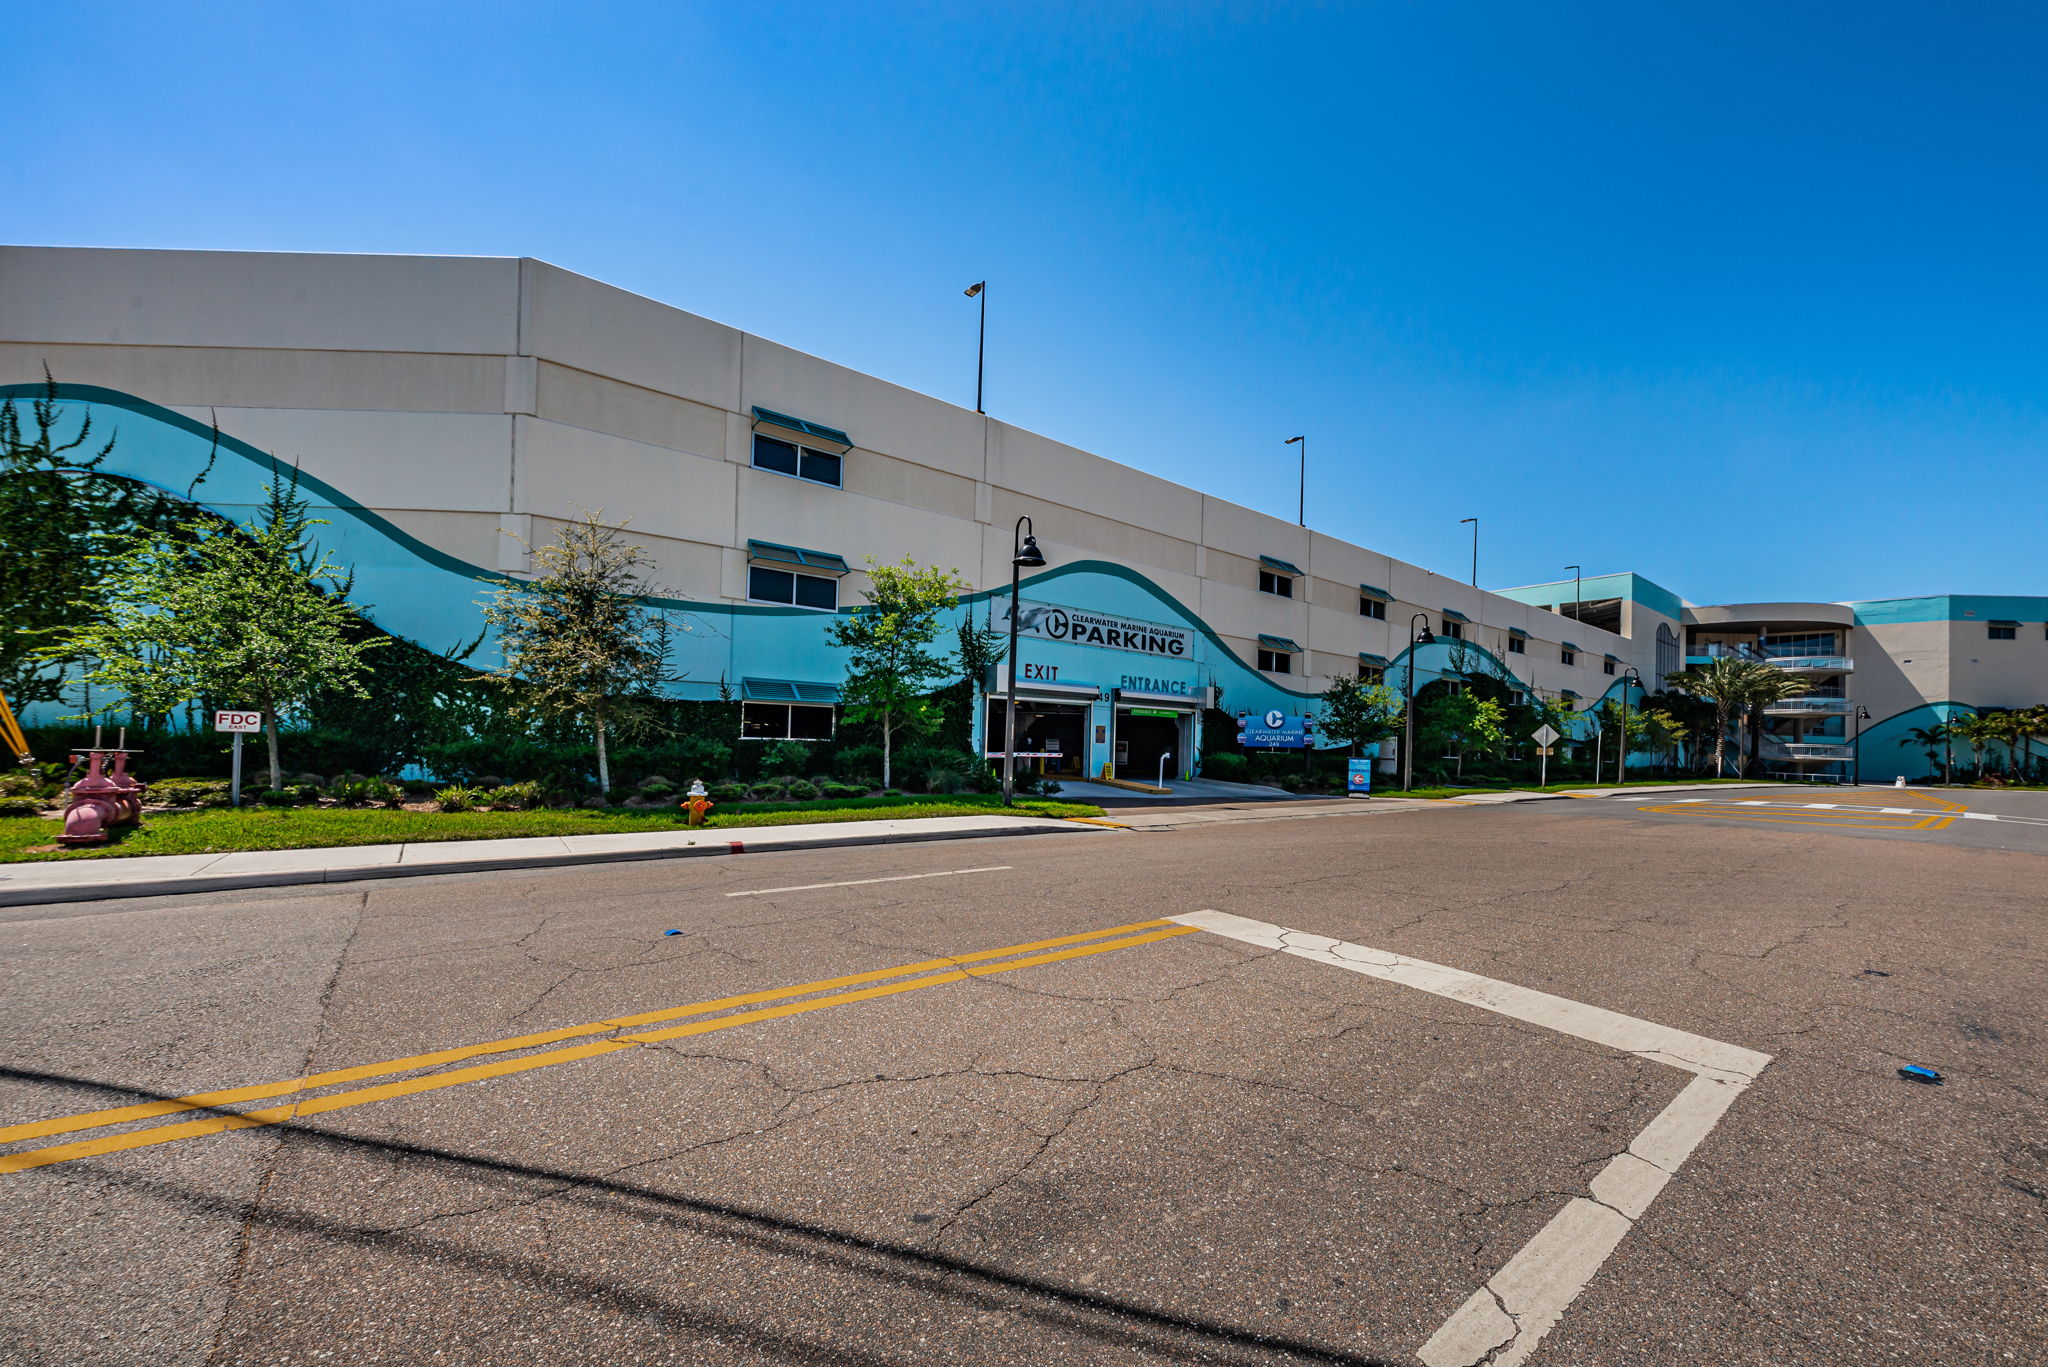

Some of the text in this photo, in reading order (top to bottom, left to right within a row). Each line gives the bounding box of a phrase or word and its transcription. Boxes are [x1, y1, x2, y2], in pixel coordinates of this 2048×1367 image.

[1072, 614, 1184, 639] CLEARWATER MARINE AQUARIUM
[1072, 623, 1184, 655] PARKING
[1025, 664, 1058, 680] EXIT
[1121, 675, 1186, 695] ENTRANCE
[219, 713, 257, 725] FDC
